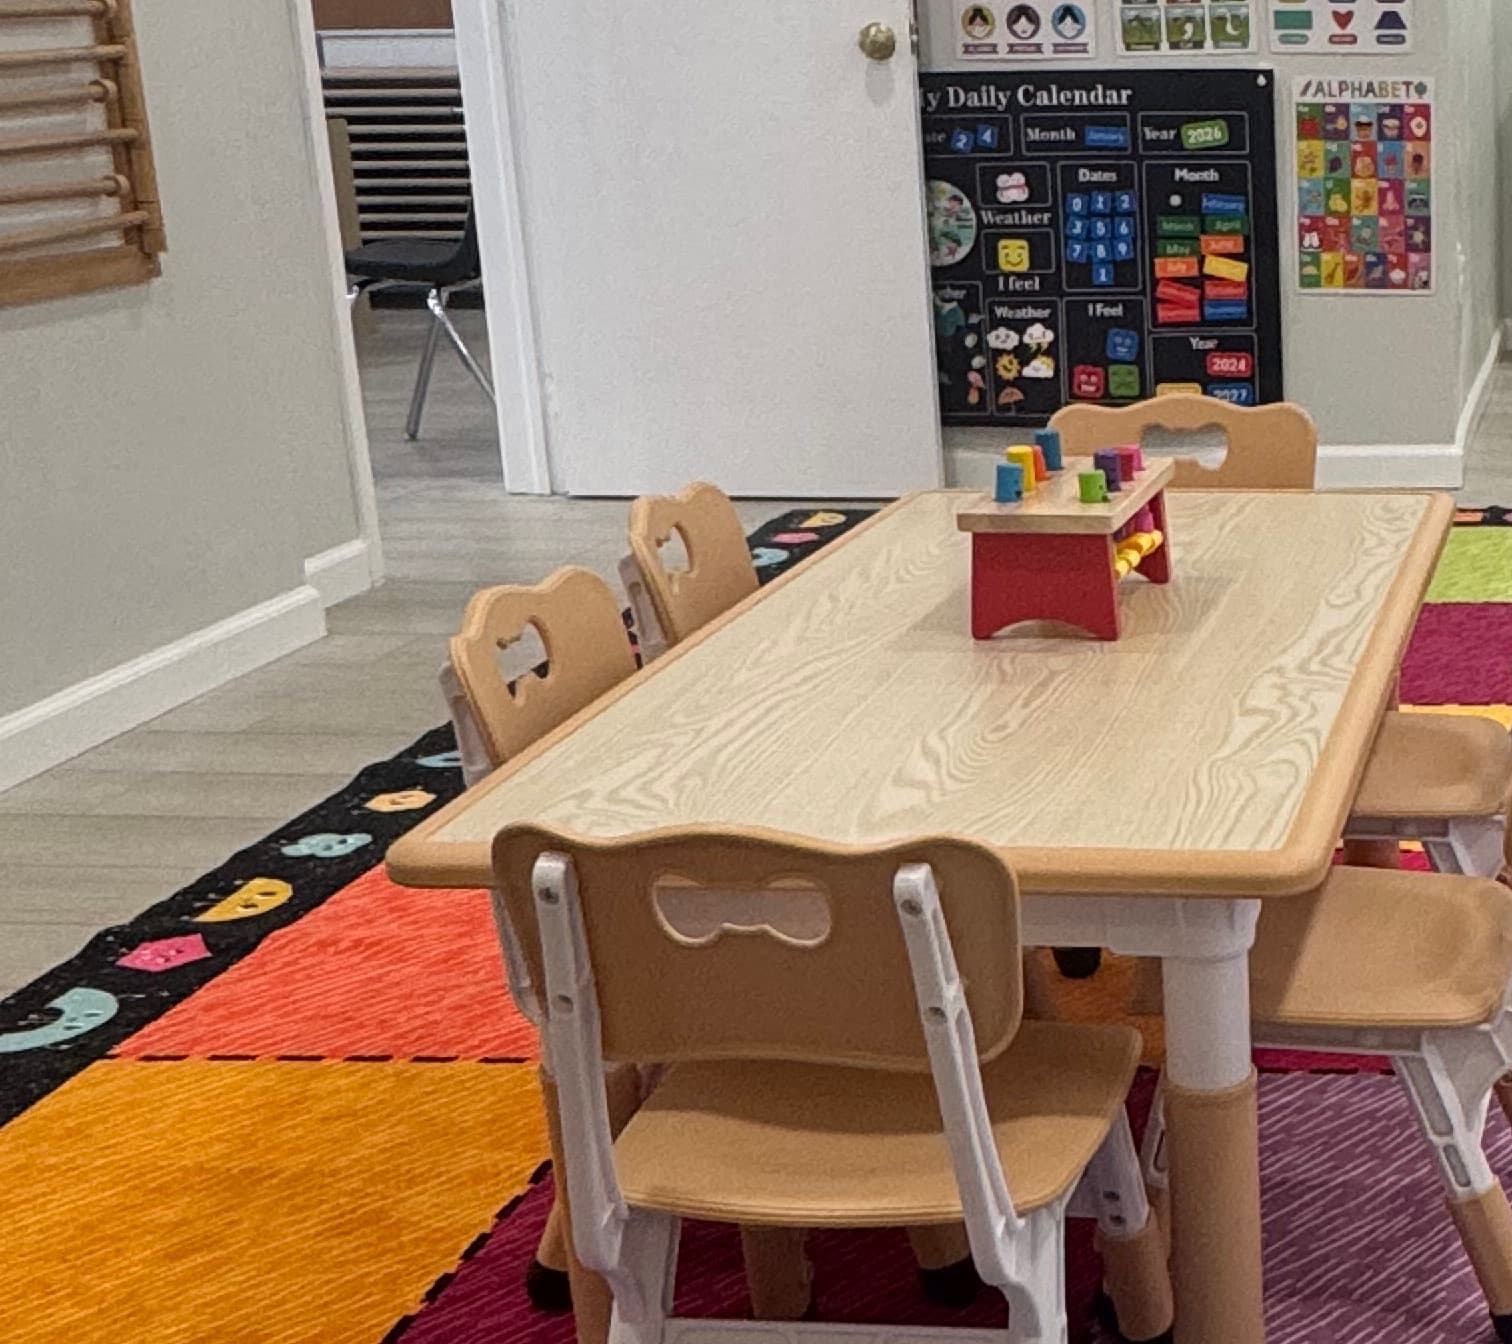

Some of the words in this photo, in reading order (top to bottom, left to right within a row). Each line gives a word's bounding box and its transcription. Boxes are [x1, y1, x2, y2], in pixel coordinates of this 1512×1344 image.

[1313, 80, 1414, 98] ALPHABET
[947, 85, 1011, 111] Daily
[1016, 84, 1133, 106] Calendar
[956, 134, 967, 149] 2
[981, 129, 992, 144] 4
[1025, 127, 1076, 143] Month
[1143, 126, 1177, 141] Year
[1186, 126, 1222, 144] 2026
[1174, 168, 1220, 182] Month
[980, 210, 1052, 225] Weather
[998, 276, 1004, 291] I
[1008, 276, 1040, 291] feel
[993, 306, 1052, 319] Weather
[1088, 303, 1094, 317] I
[1096, 303, 1123, 317] Feel
[1211, 358, 1246, 372] 2024
